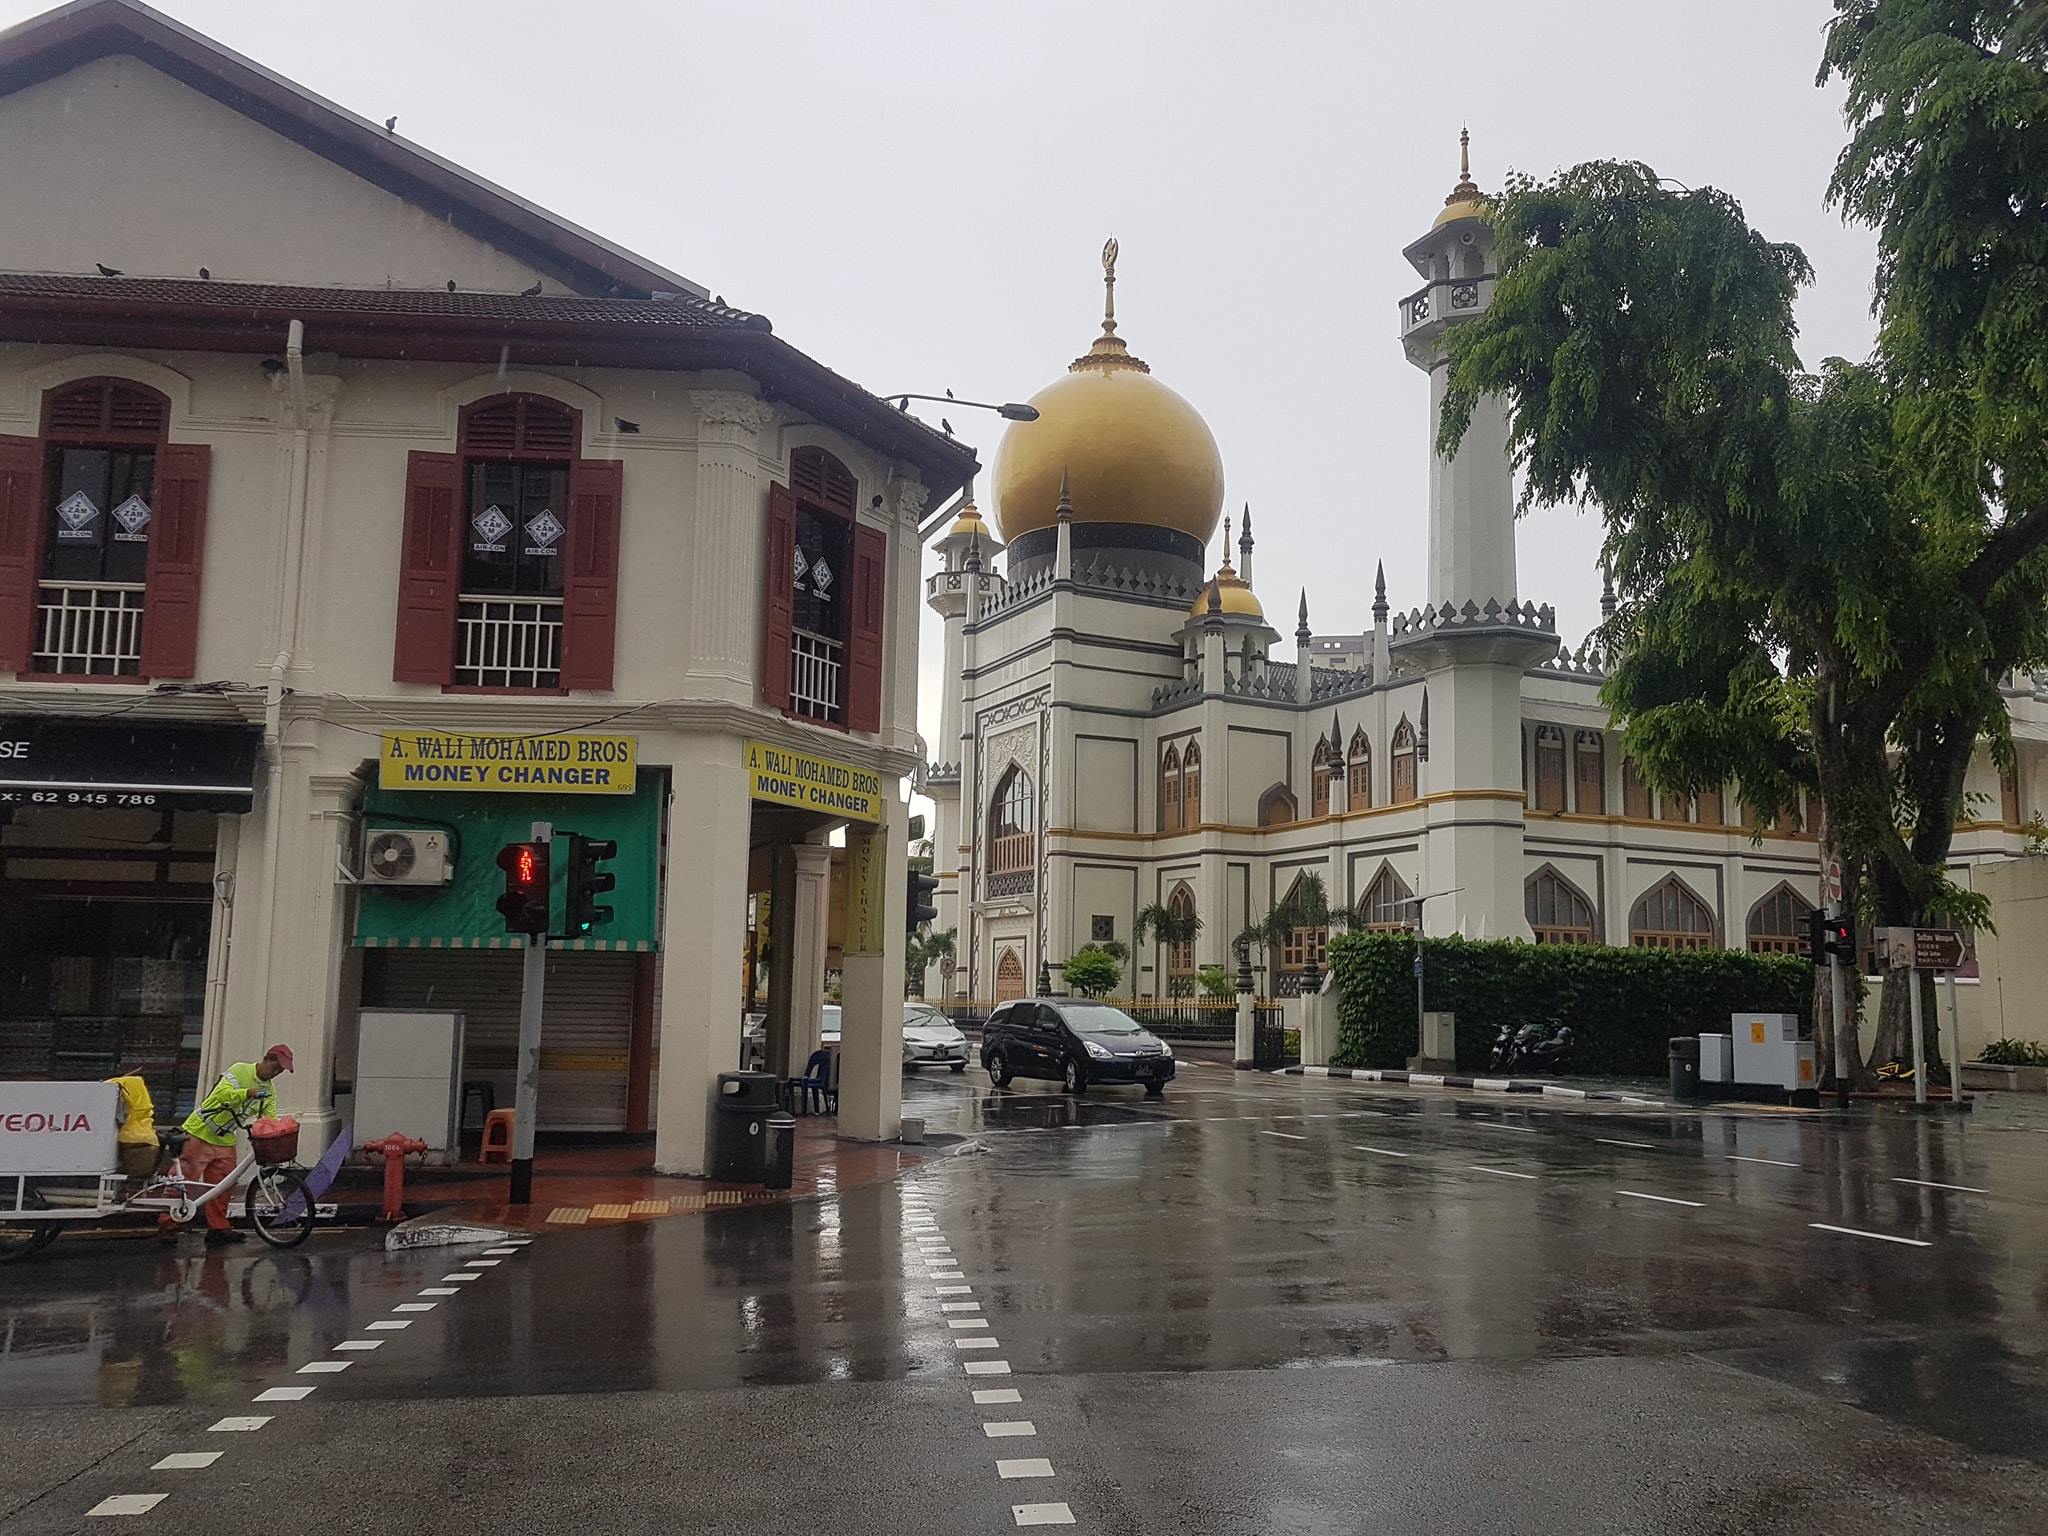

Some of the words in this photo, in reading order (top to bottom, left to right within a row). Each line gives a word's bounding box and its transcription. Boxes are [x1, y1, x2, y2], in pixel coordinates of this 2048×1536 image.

[0, 741, 30, 758] SE
[390, 736, 408, 758] A.
[416, 737, 464, 760] WALI
[470, 738, 571, 762] MOHAMED
[577, 740, 629, 763] BROS
[405, 764, 491, 783] MONEY
[498, 766, 611, 785] CHANGER
[749, 747, 761, 769] A.
[765, 750, 792, 776] WALI
[795, 758, 850, 789] MOHAMED
[852, 772, 879, 796] BROS
[32, 792, 58, 802] 62
[68, 793, 108, 804] 945
[116, 794, 156, 805] 786
[617, 784, 632, 792] 695
[758, 775, 806, 800] MONEY
[809, 787, 869, 813] CHANGER
